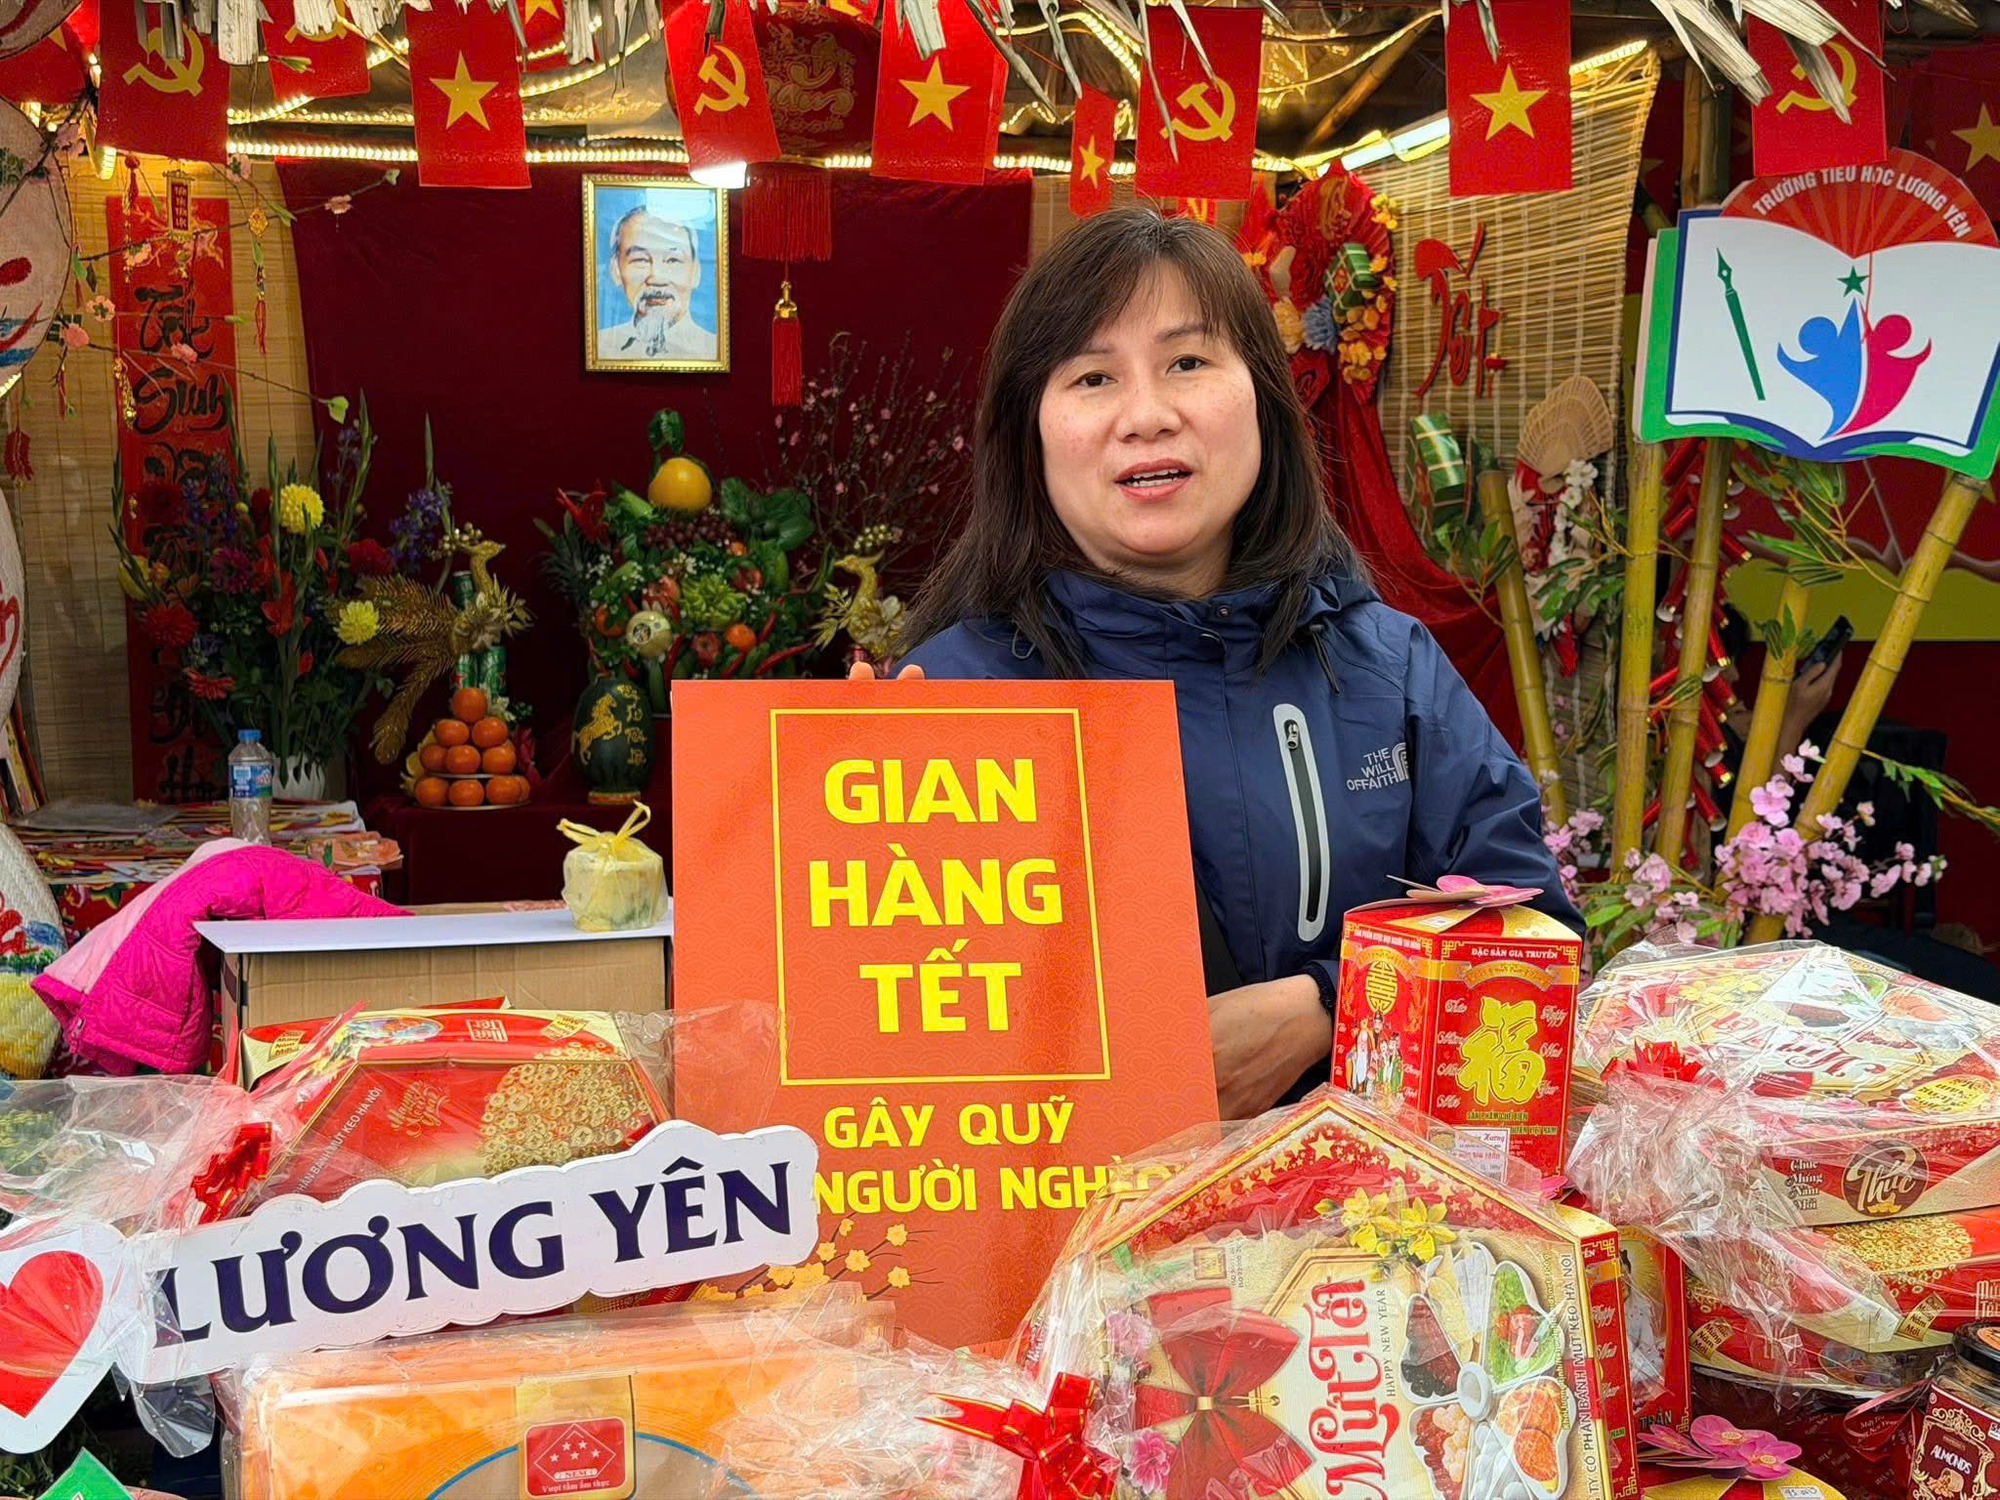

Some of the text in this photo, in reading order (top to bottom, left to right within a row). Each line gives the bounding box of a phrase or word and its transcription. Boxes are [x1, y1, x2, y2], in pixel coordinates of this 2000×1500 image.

[1752, 172, 1817, 216] TRƯỜNG
[1896, 173, 1947, 211] LƯƠNG
[1942, 204, 1972, 239] YÊN
[1346, 771, 1399, 791] OFFAITH
[1361, 760, 1395, 778] WILL
[1363, 747, 1391, 765] THE
[823, 758, 1038, 824] GIAN
[809, 843, 1063, 928] HÀNG
[1508, 948, 1524, 958] GIA
[859, 938, 1022, 1034] TẾT
[823, 1097, 935, 1149] GÂY
[959, 1094, 1075, 1147] QUỸ
[814, 1158, 977, 1215] NGƯỜI
[153, 1156, 792, 1349] LƯƠNG YÊN
[1302, 1276, 1371, 1382] Tết
[1376, 1288, 1396, 1397] HAPPY NEW YEAR
[1574, 1369, 1590, 1411] BÁNH
[1589, 1478, 1600, 1493] TY
[1930, 1444, 1973, 1475] ALMONDS
